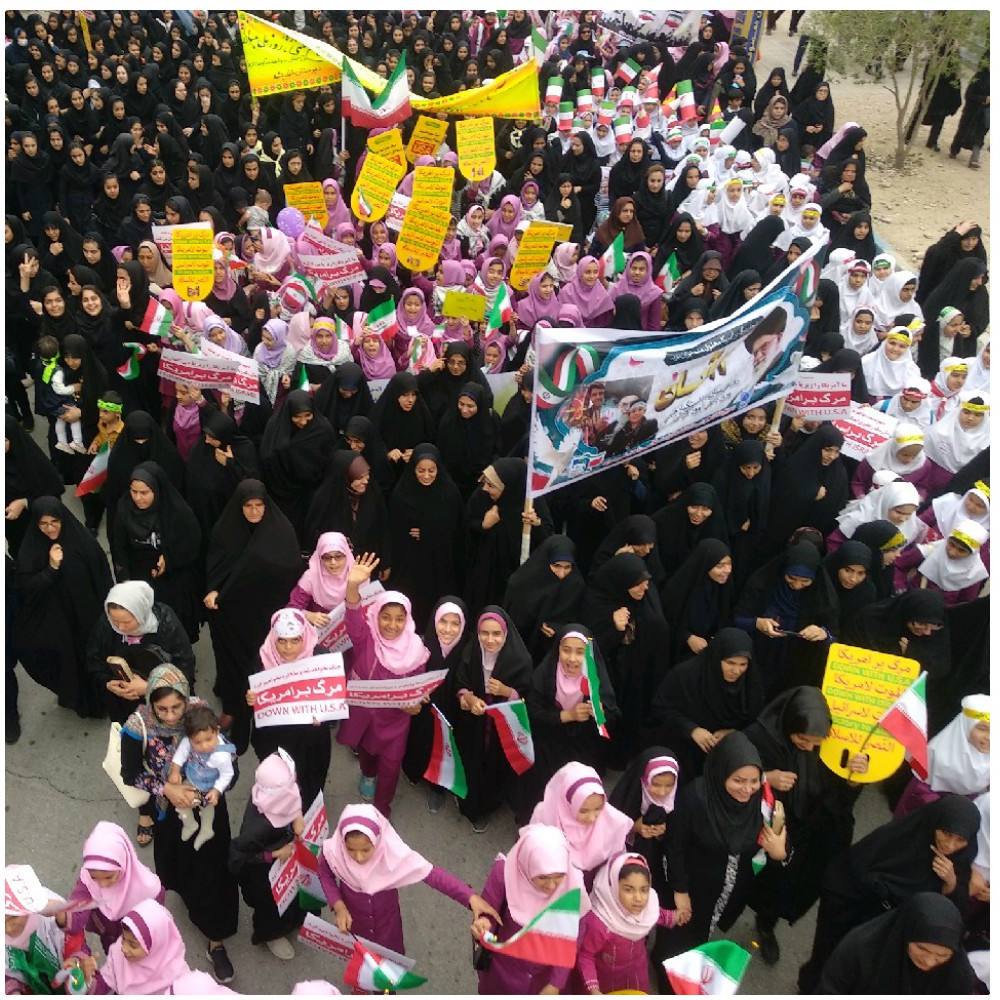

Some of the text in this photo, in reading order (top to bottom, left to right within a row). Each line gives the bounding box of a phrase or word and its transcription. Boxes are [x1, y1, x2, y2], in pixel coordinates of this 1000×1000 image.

[294, 685, 312, 699] بر
[313, 679, 343, 697] مرگ
[257, 706, 289, 720] DOWN
[292, 703, 318, 715] WITH
